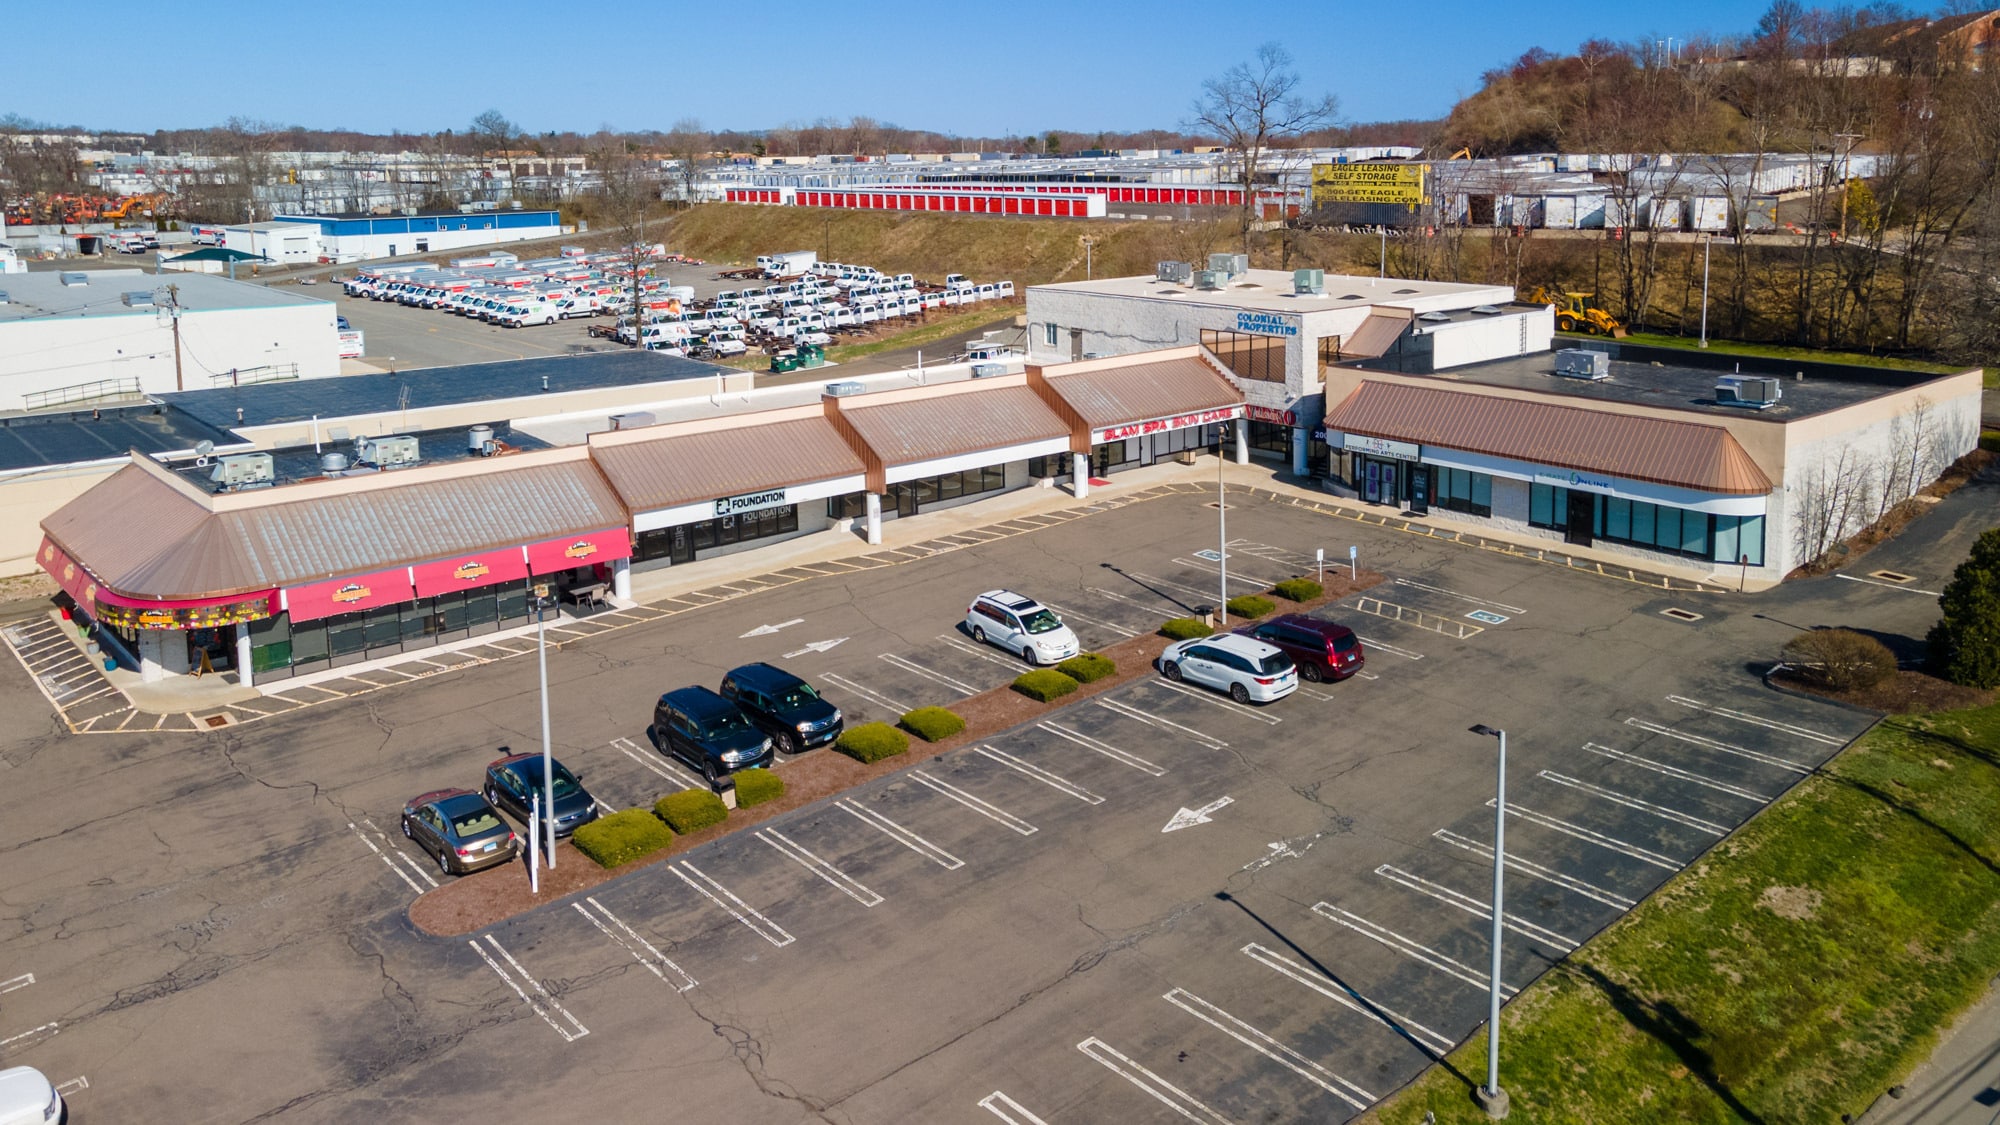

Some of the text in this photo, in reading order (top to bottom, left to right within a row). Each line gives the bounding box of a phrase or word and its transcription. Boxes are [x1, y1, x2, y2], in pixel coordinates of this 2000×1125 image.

[1332, 164, 1400, 172] EAGLE LEASING
[1237, 313, 1284, 324] COLONIAL
[1237, 322, 1297, 335] PROPERTIES
[1103, 425, 1139, 441] GLAM
[1142, 420, 1167, 434] SPA
[1171, 414, 1200, 429] SKIN
[1202, 407, 1233, 423] CARE
[1395, 452, 1417, 460] CENTER
[732, 490, 785, 509] FOUNDATION
[742, 505, 792, 522] FOUNDATION
